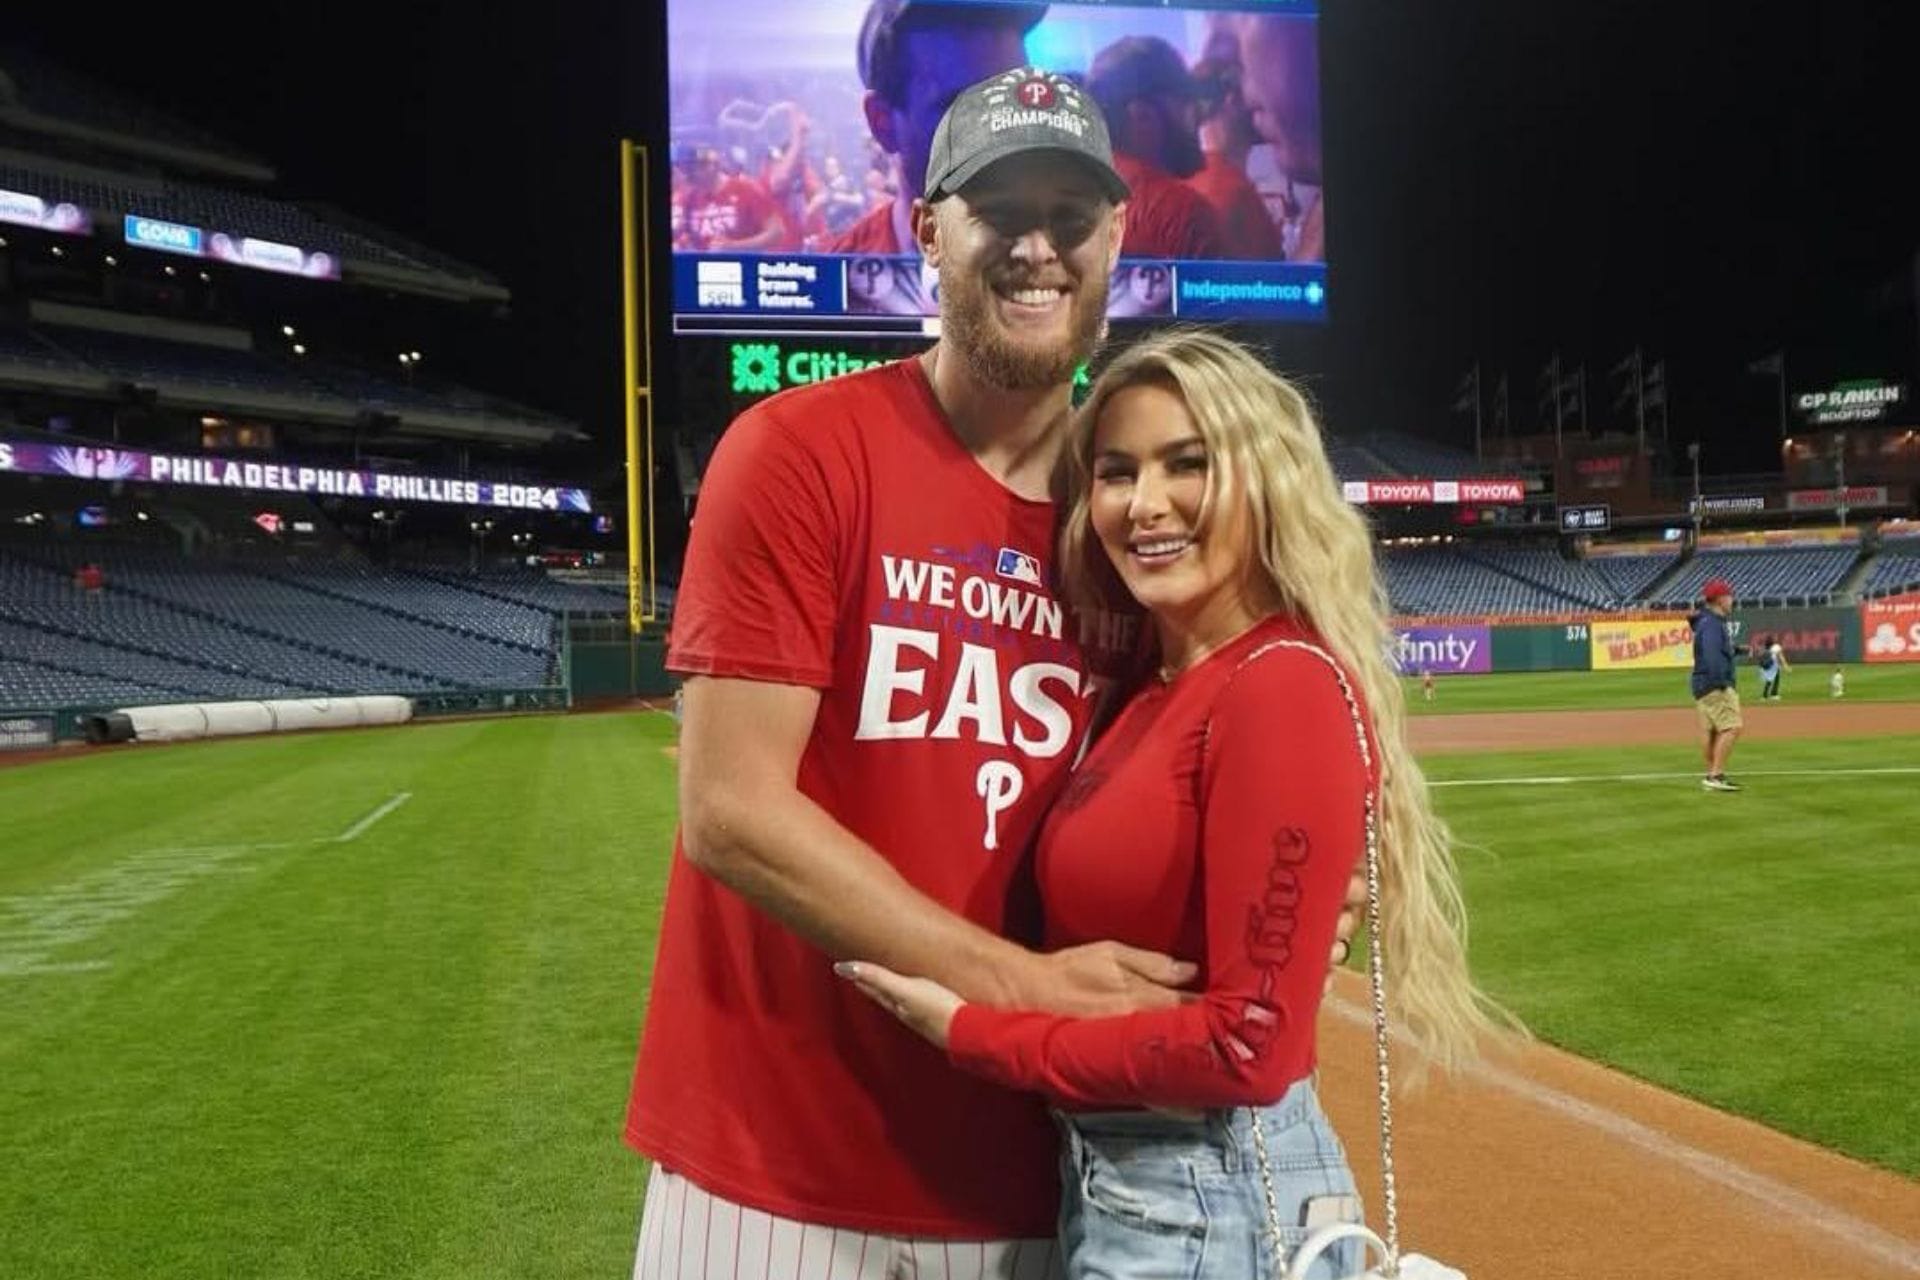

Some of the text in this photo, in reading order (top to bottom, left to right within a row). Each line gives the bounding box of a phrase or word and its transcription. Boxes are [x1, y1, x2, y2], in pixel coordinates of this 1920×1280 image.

[757, 262, 816, 281] Building
[1182, 280, 1301, 303] Independence
[786, 351, 902, 384] Citiz
[1799, 392, 1826, 409] CP
[1828, 386, 1900, 406] RANKIN
[150, 455, 559, 510] PHILADELPHIA PHILLIES 2024
[1371, 485, 1431, 499] TOYOTA
[1461, 484, 1521, 499] TOYOTA
[881, 554, 956, 610] WE
[961, 575, 1064, 640] OWN
[1751, 624, 1839, 651] GANT
[976, 759, 1024, 850] P
